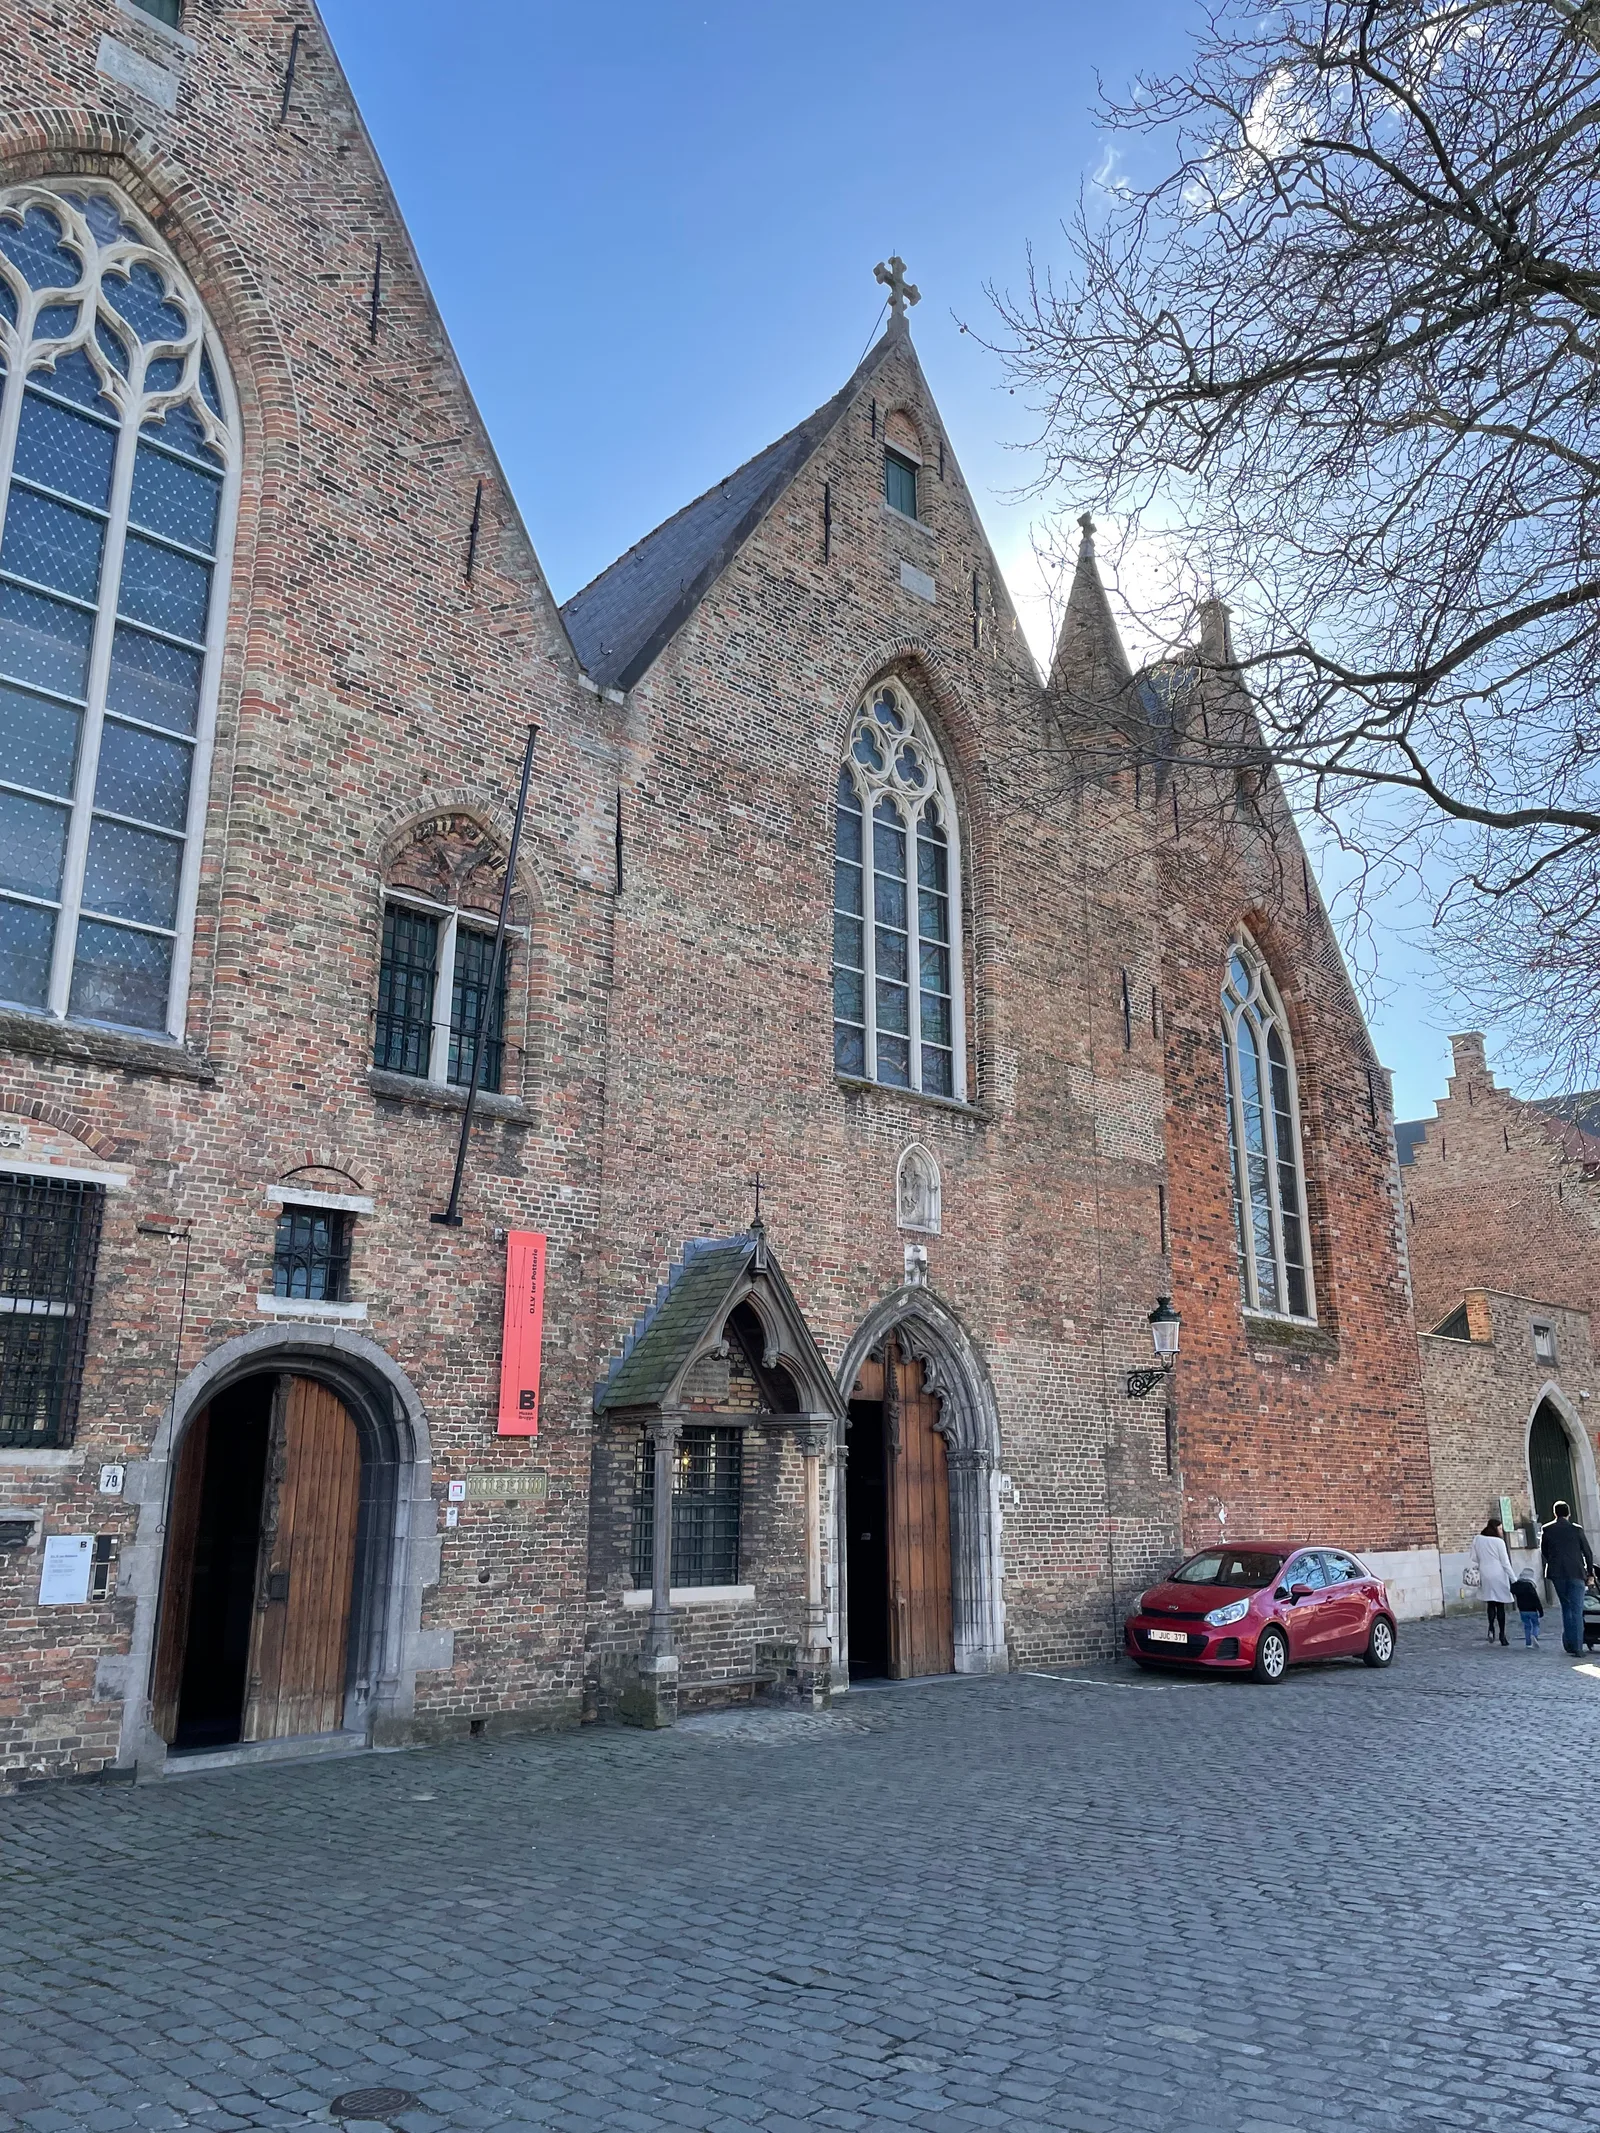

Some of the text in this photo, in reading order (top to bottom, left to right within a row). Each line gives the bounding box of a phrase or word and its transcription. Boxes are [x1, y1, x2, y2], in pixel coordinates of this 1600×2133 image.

[519, 1390, 536, 1410] B
[106, 1475, 118, 1488] 79
[1159, 1632, 1170, 1640] JUC
[1174, 1633, 1186, 1641] 377
